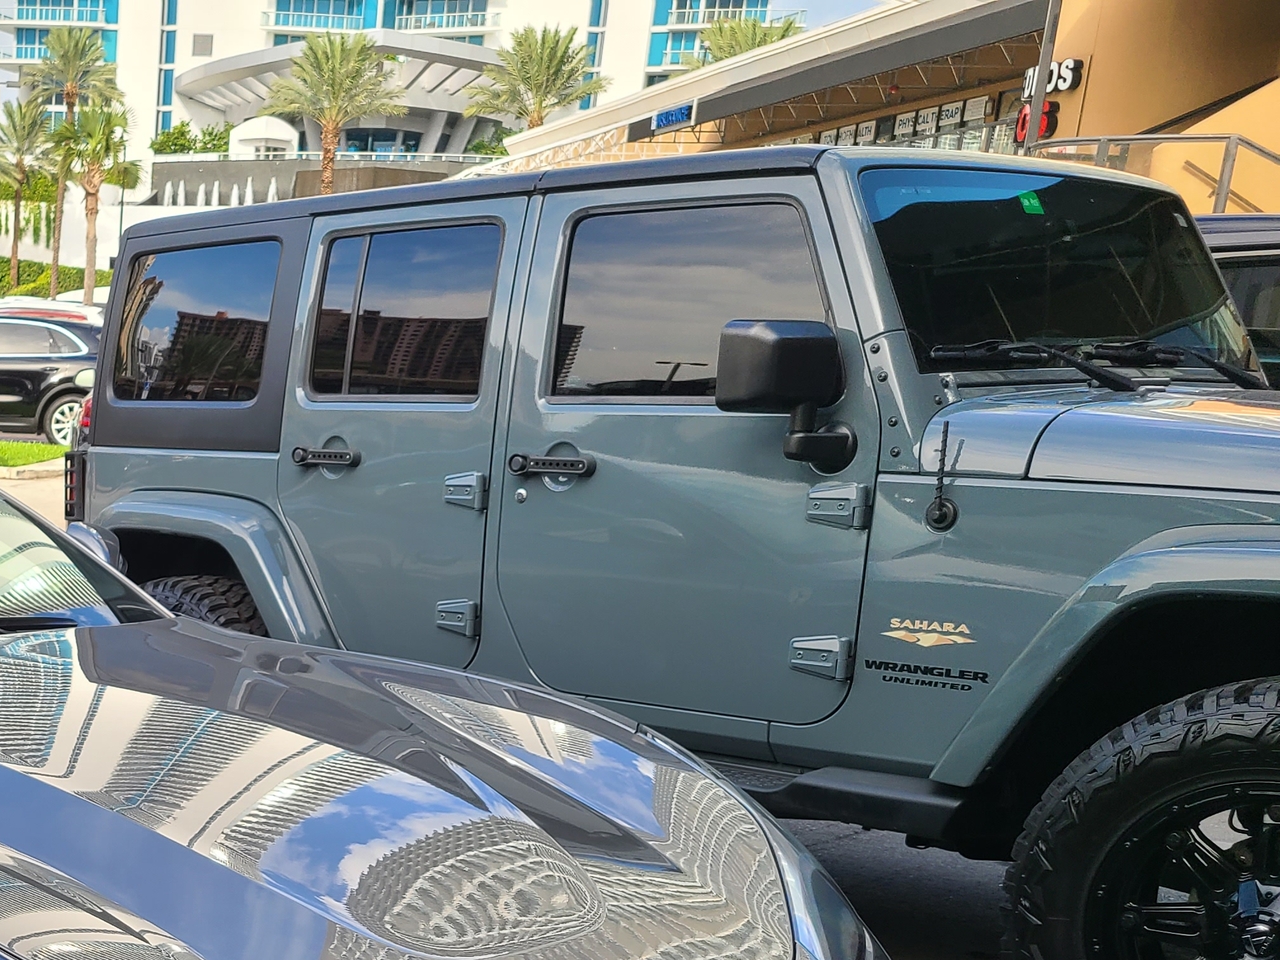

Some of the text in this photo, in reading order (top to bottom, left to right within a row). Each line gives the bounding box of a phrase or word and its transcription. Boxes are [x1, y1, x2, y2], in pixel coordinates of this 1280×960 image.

[898, 113, 929, 130] PHYSCAL
[890, 618, 970, 633] SAHARA
[864, 659, 990, 684] WRANGLER
[882, 675, 973, 692] UNLIMITED
